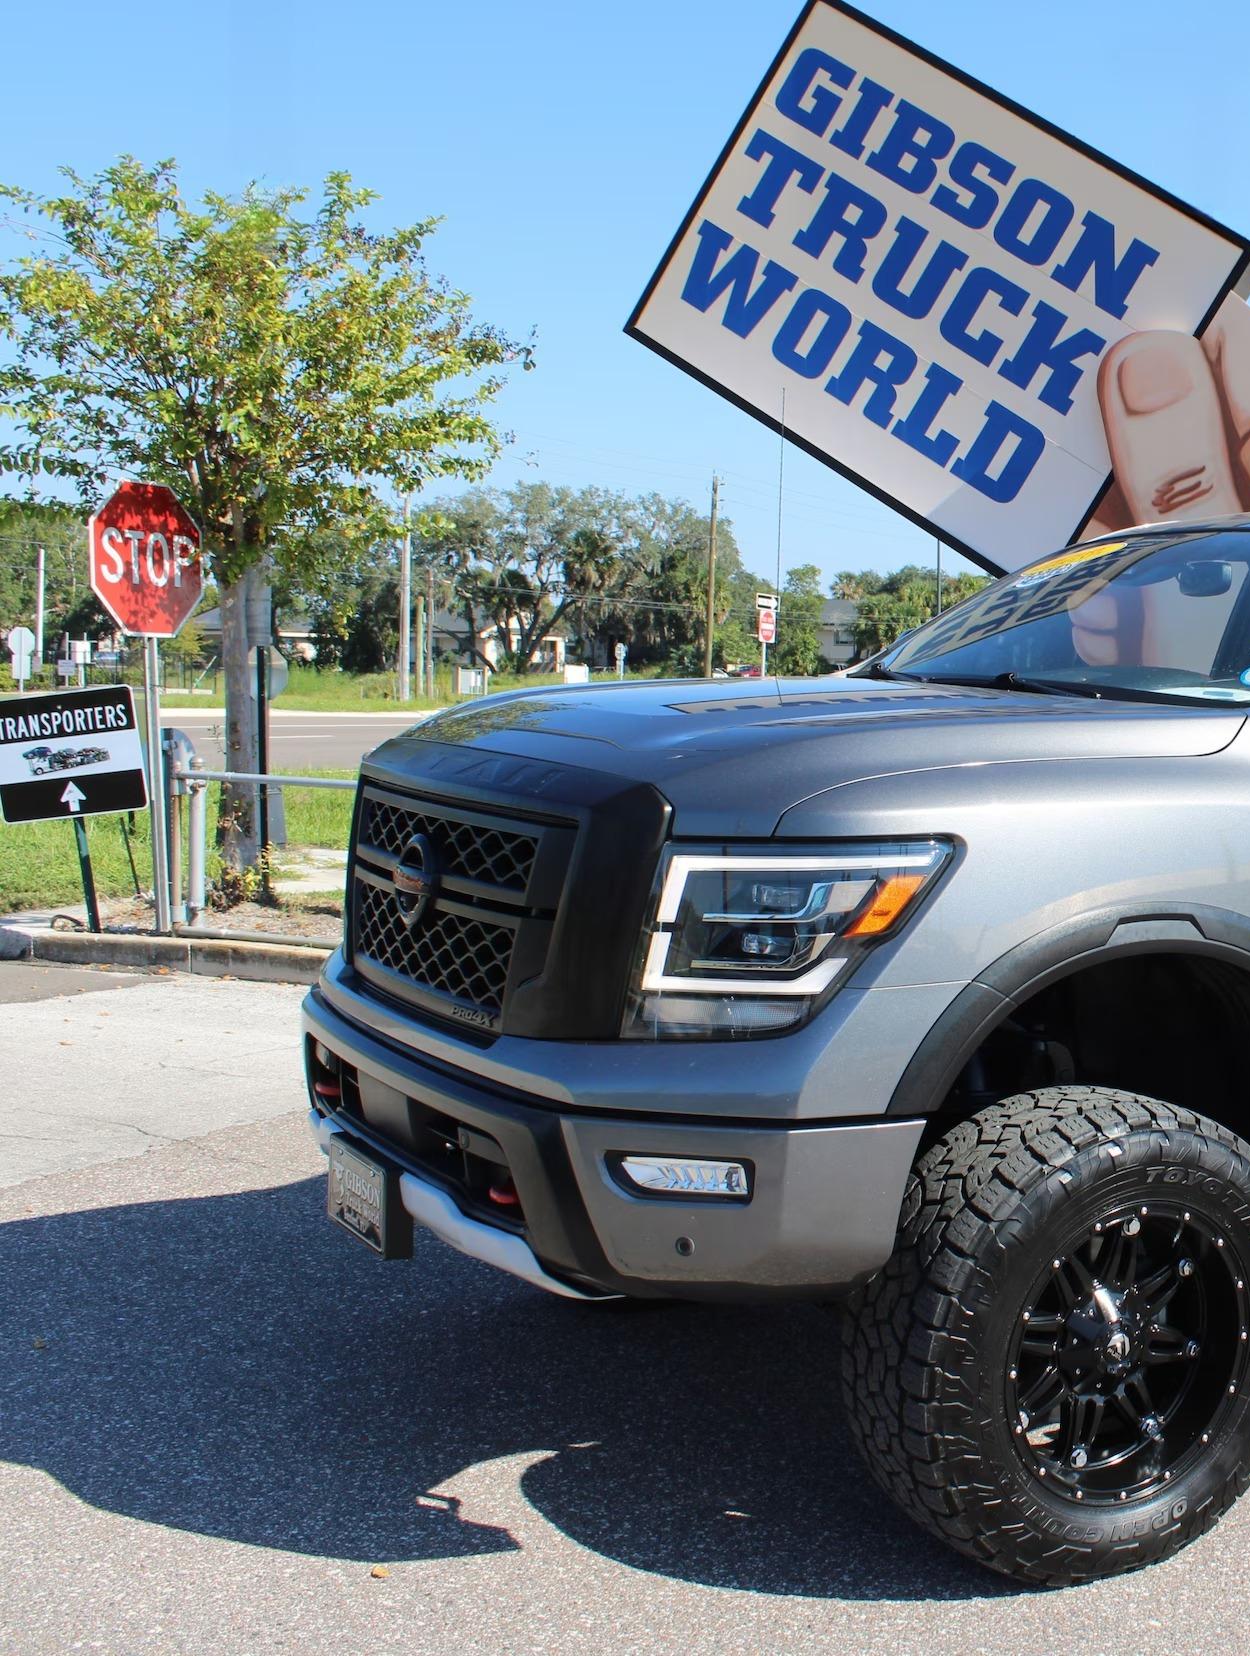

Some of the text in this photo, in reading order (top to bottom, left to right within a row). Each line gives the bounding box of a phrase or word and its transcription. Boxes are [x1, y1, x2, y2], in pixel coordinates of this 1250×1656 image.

[775, 47, 1160, 319] GIBSON
[736, 128, 1105, 416] TRUCK
[681, 219, 1045, 503] WORLD
[100, 526, 196, 588] STOP
[345, 1169, 382, 1209] GIBSON
[1146, 1166, 1224, 1195] TOYO
[1109, 1498, 1188, 1544] OPEN
